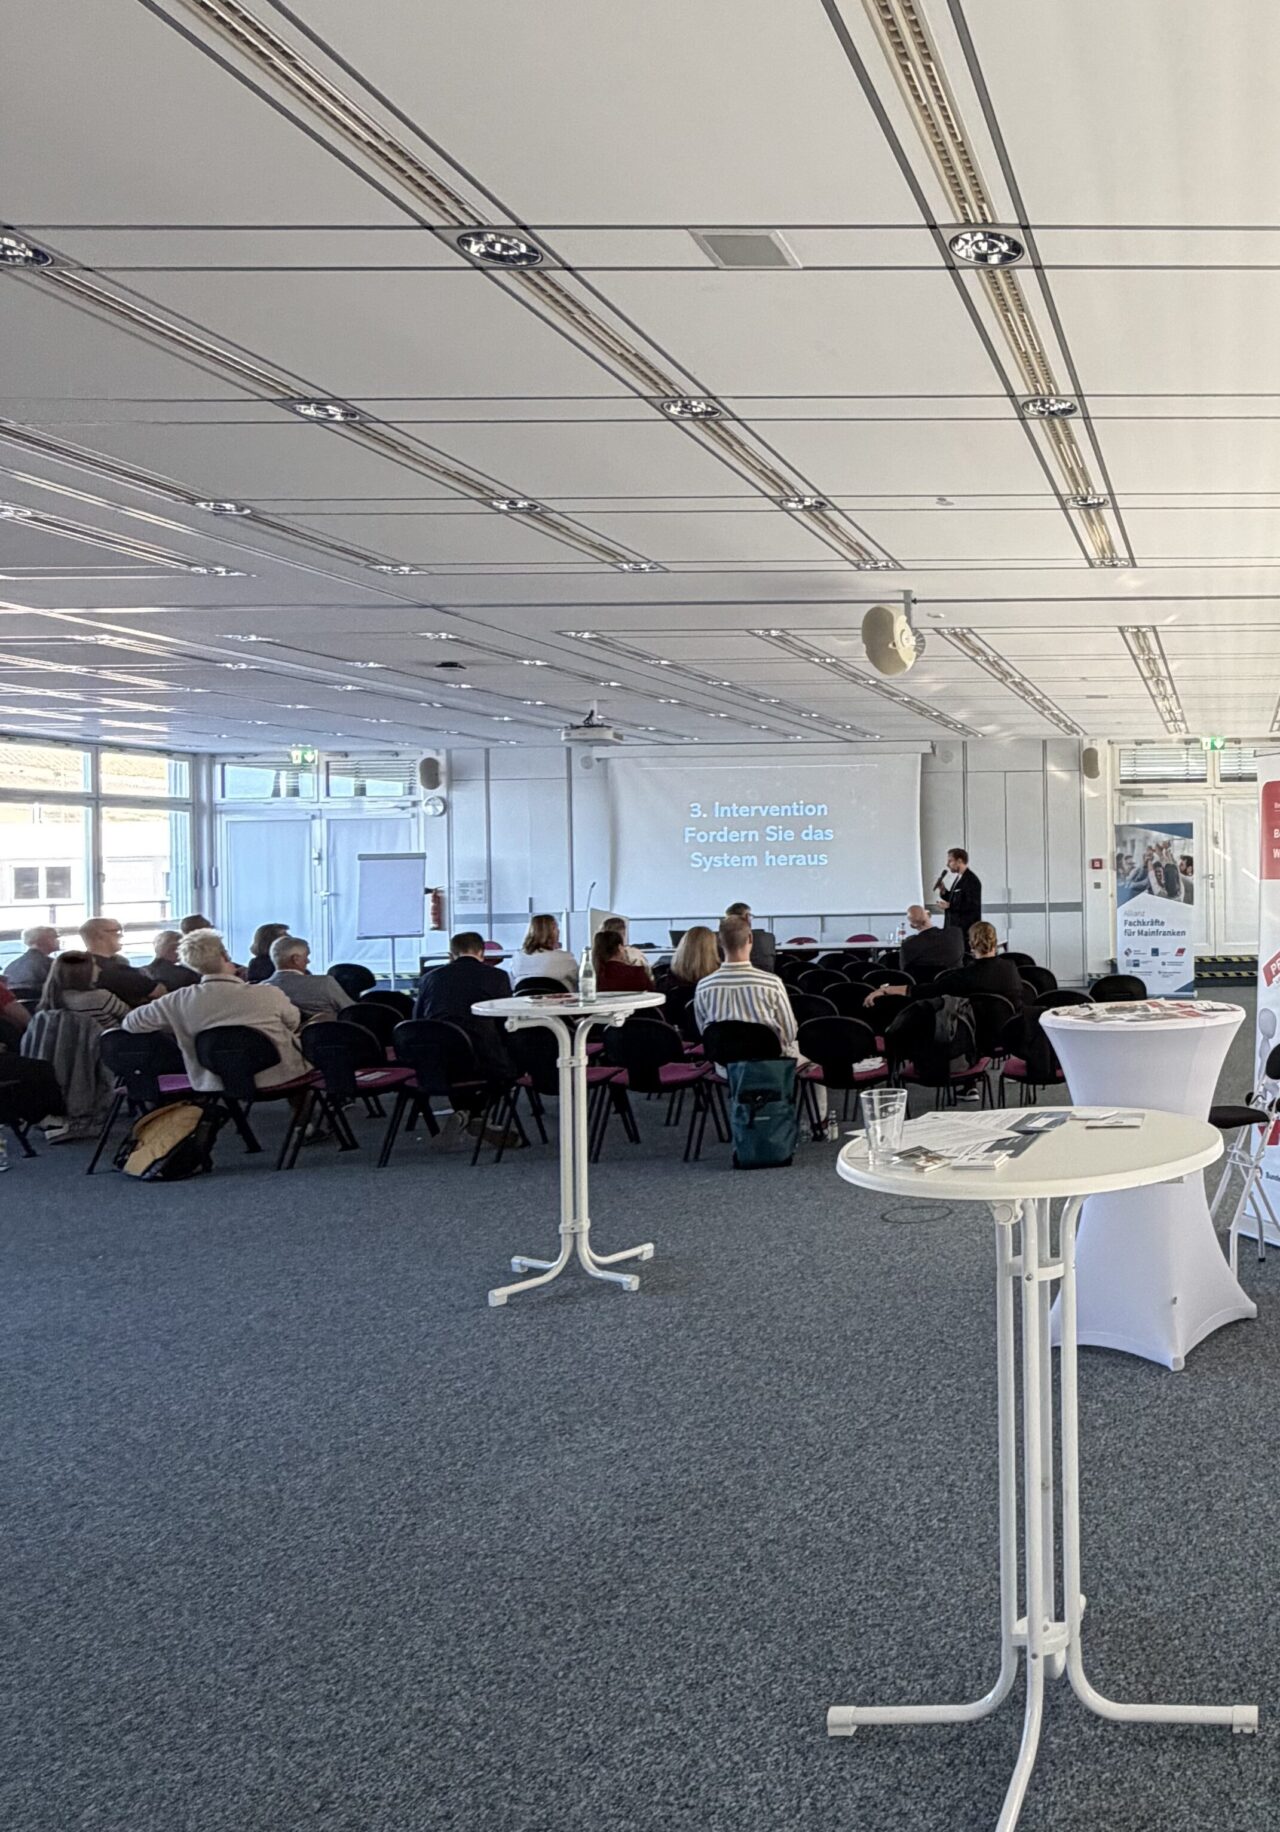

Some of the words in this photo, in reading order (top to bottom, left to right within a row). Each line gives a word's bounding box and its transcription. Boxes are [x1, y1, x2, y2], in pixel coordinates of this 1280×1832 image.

[690, 803, 707, 818] 3.
[714, 800, 828, 818] Intervention
[684, 827, 759, 843] Fordern
[765, 825, 794, 842] Sie
[801, 824, 834, 841] das
[690, 852, 758, 872] System
[765, 851, 828, 867] heraus
